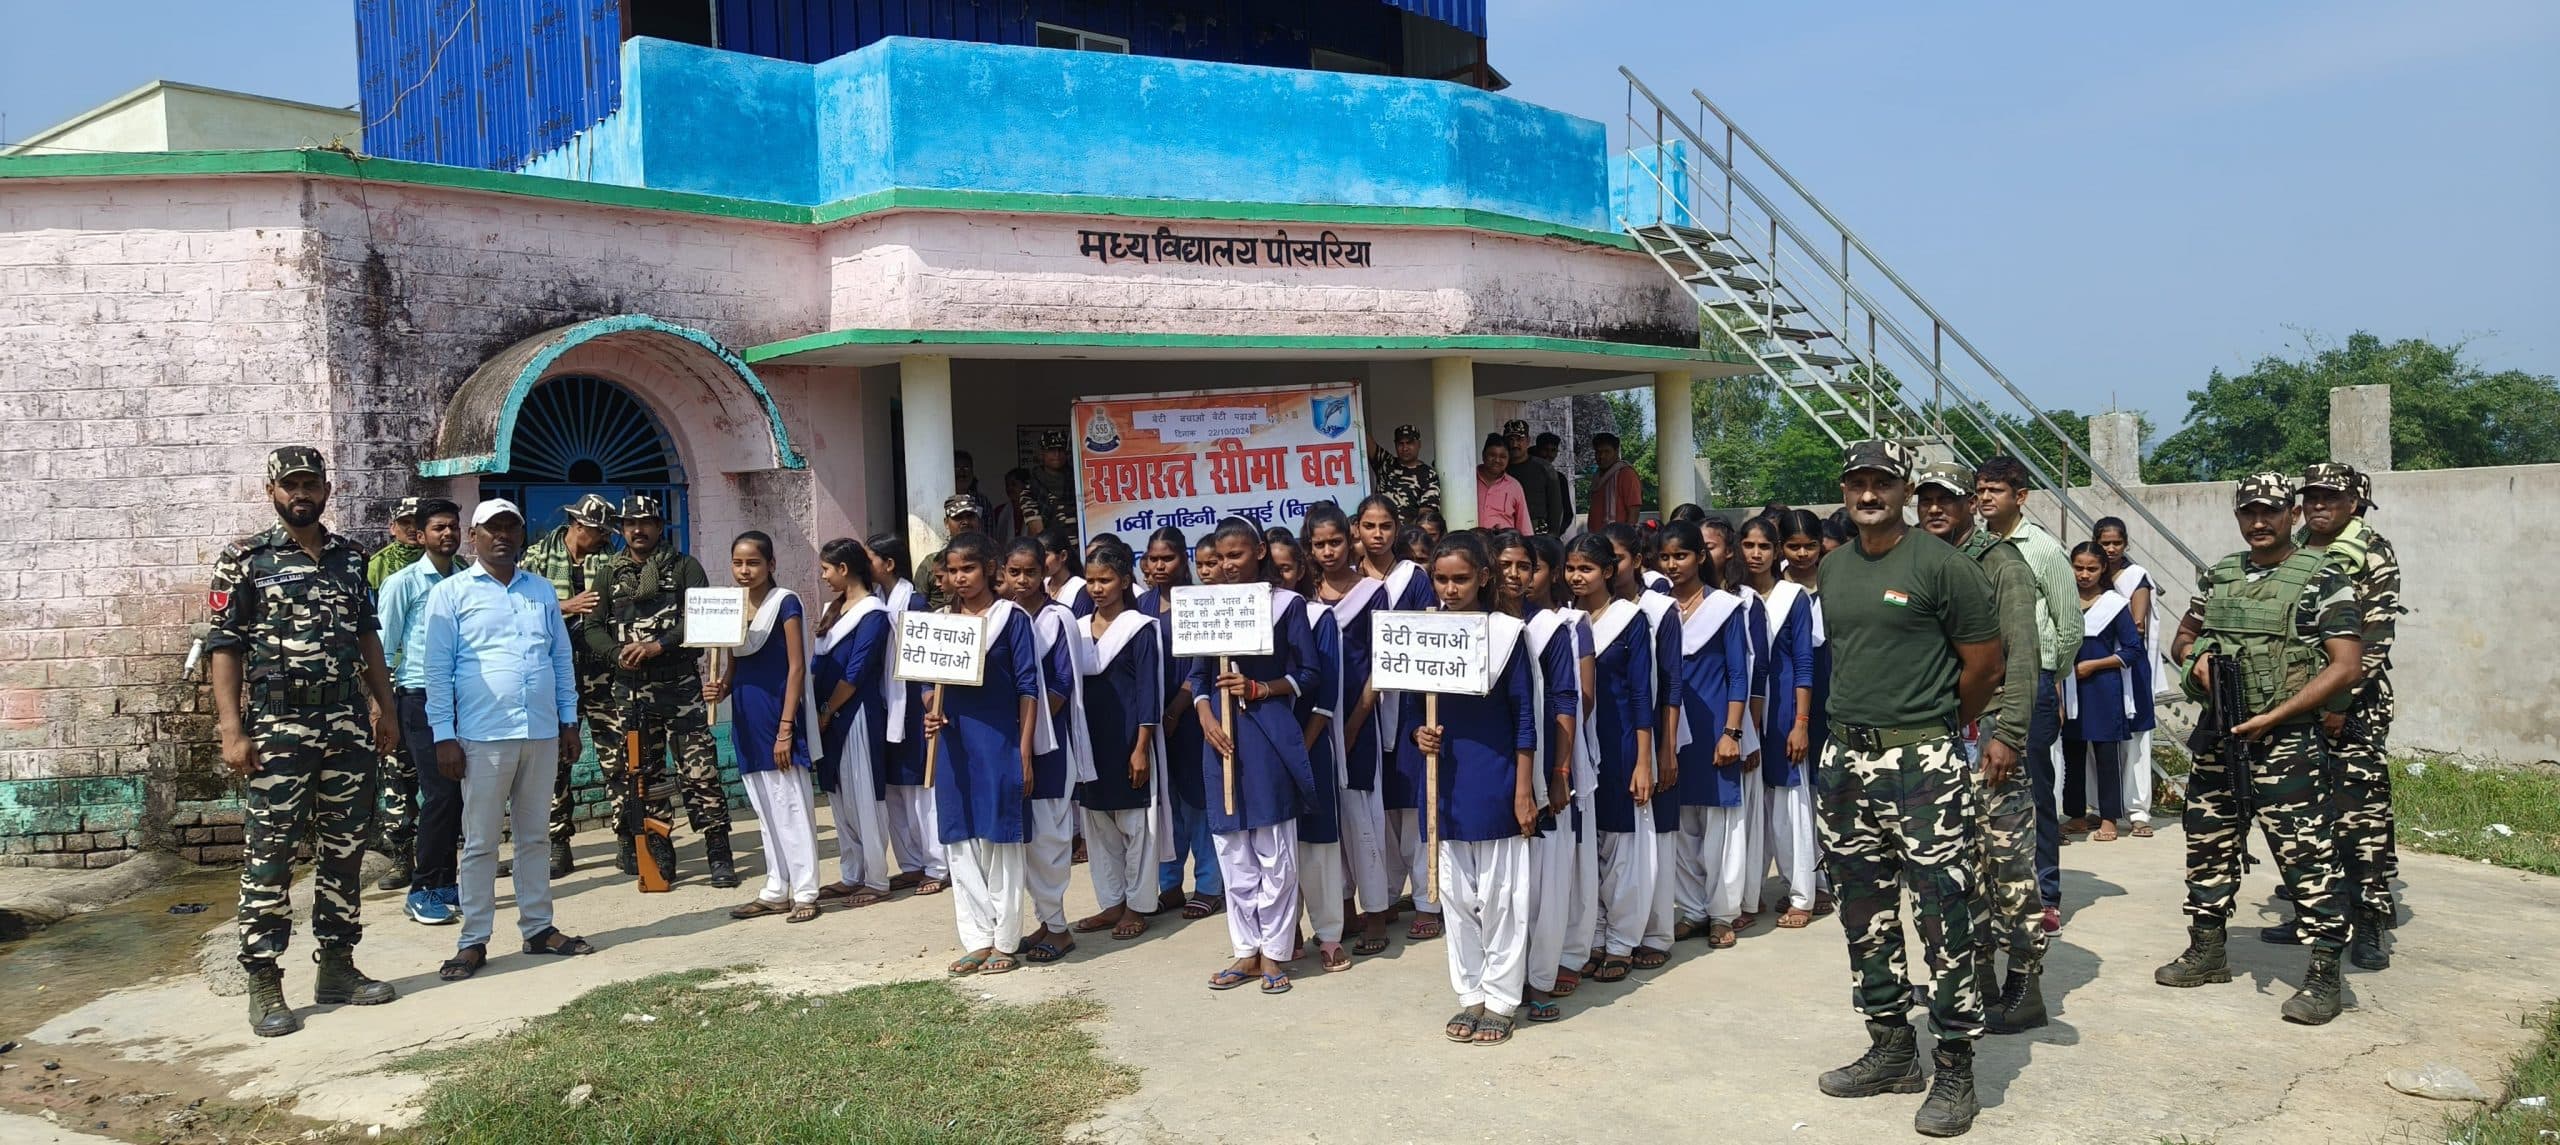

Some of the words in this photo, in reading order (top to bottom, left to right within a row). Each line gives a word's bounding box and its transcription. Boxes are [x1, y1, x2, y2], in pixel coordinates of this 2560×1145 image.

[1078, 229, 1149, 264] मध्य
[1152, 226, 1258, 266] विद्यालय
[1261, 229, 1372, 268] पोखरिया
[1095, 423, 1109, 435] SSB
[1085, 452, 1198, 504] सशस्त्र
[1205, 437, 1289, 495] सीमा
[1296, 442, 1356, 487] बल
[1115, 509, 1153, 533] 16वीं
[1213, 607, 1234, 617] अपनी
[1239, 606, 1255, 617] सोच
[1222, 597, 1241, 606] भारत
[905, 619, 930, 640] बेटी
[932, 626, 976, 646] बचाओ
[1233, 619, 1256, 629] सहारा
[1193, 630, 1209, 642] होती
[1381, 623, 1412, 646] बेटी
[1415, 628, 1471, 650] बचाओ
[902, 643, 926, 664] बेटी
[1380, 650, 1411, 674] बेटी
